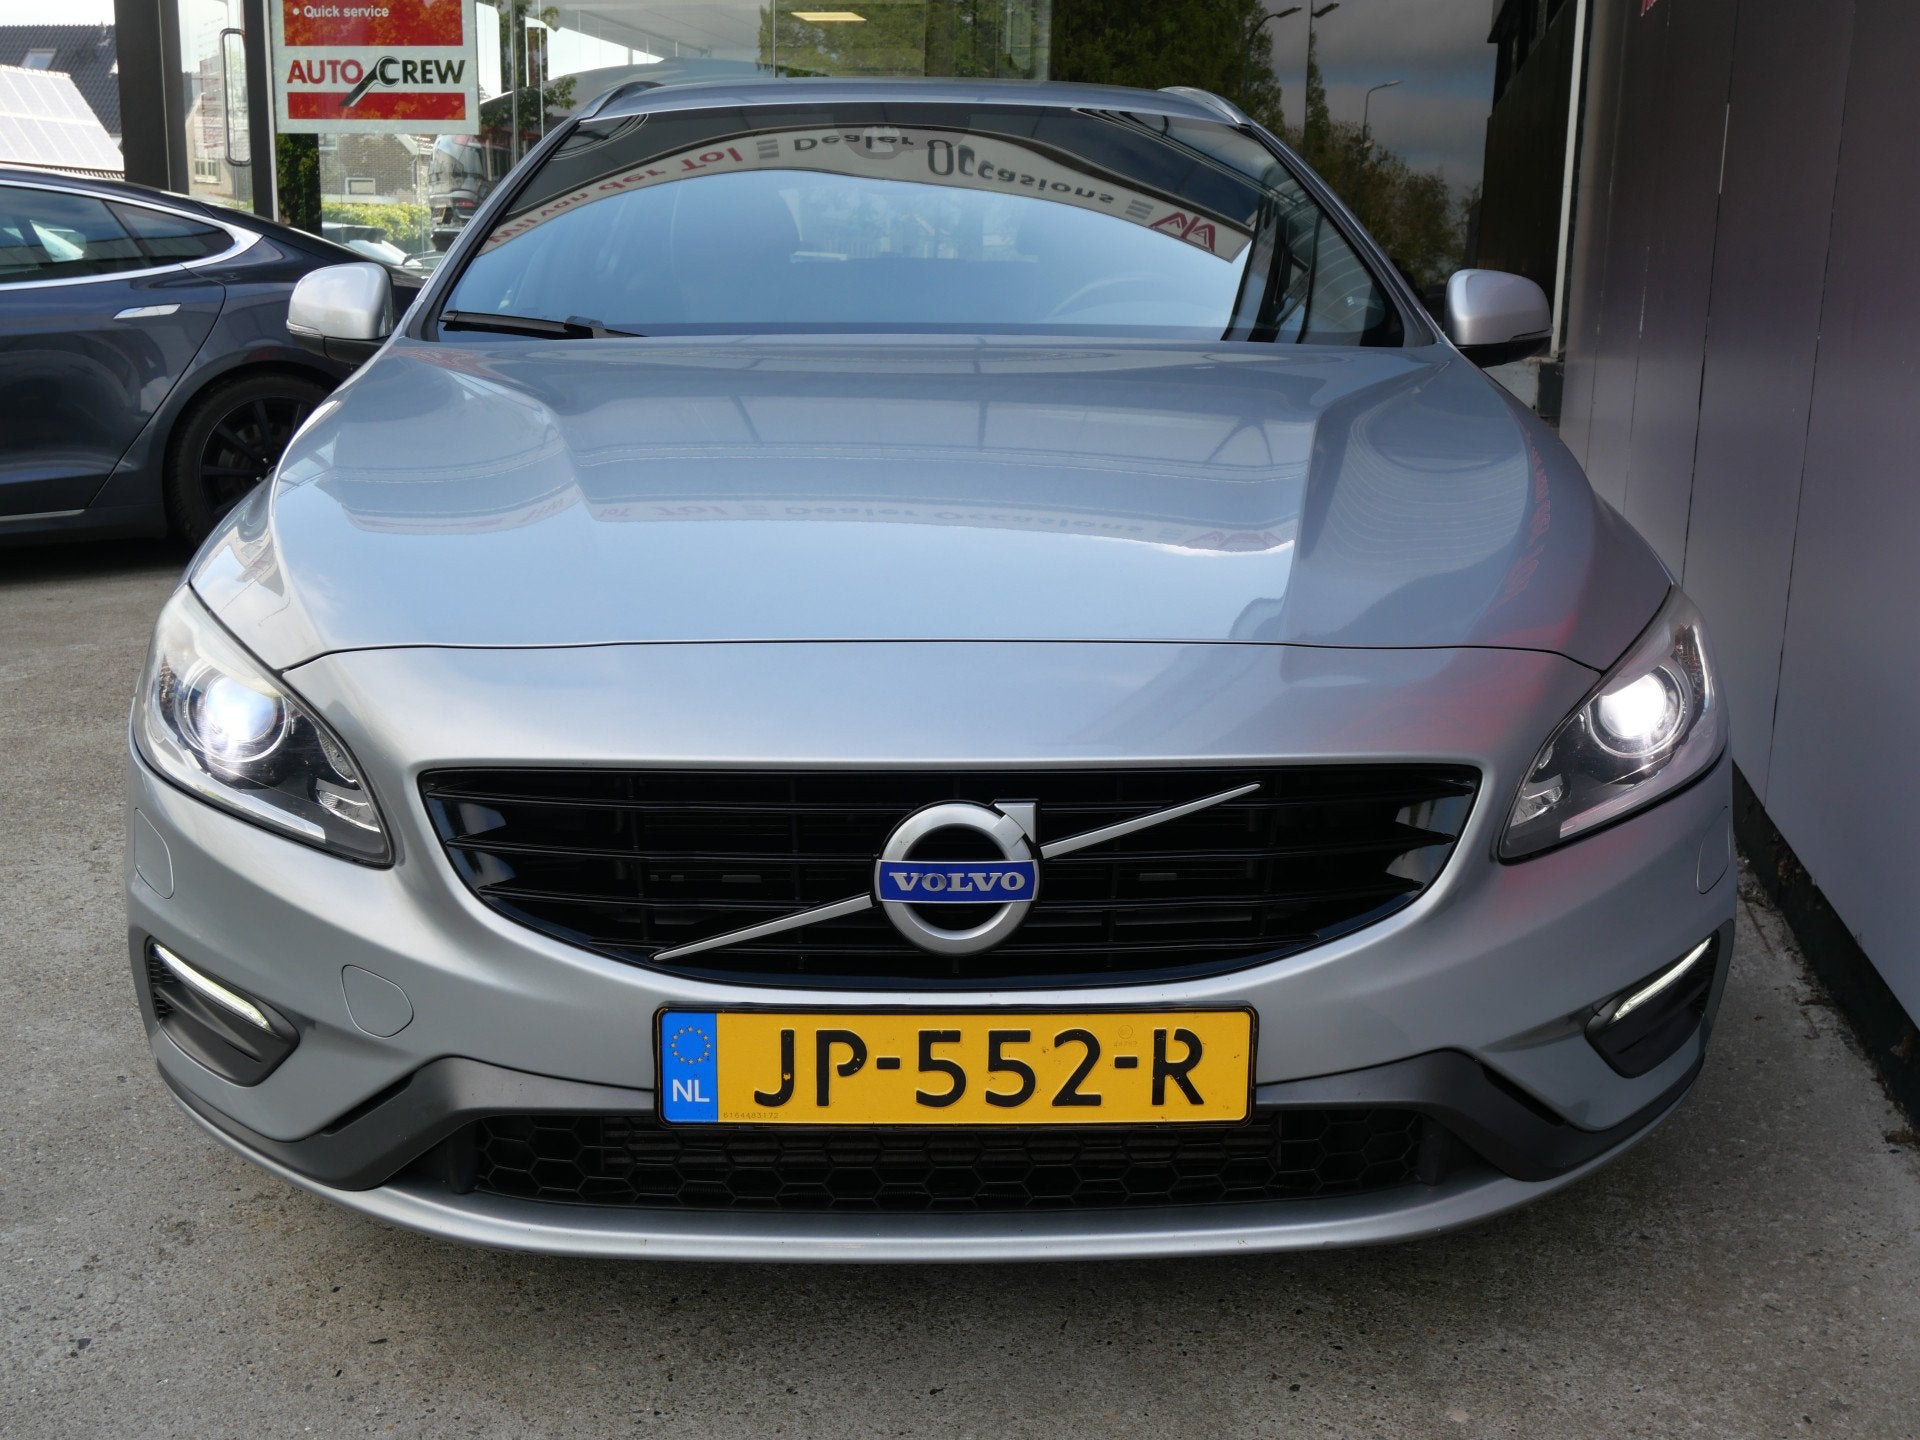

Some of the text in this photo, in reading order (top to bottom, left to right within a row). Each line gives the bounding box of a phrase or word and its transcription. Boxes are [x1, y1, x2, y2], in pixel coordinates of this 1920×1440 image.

[303, 5, 390, 18] Quick service
[287, 57, 465, 85] AUTO CREW
[889, 872, 1026, 892] VOLVO
[753, 1028, 1206, 1108] JP-552-R
[672, 1079, 710, 1103] NL
